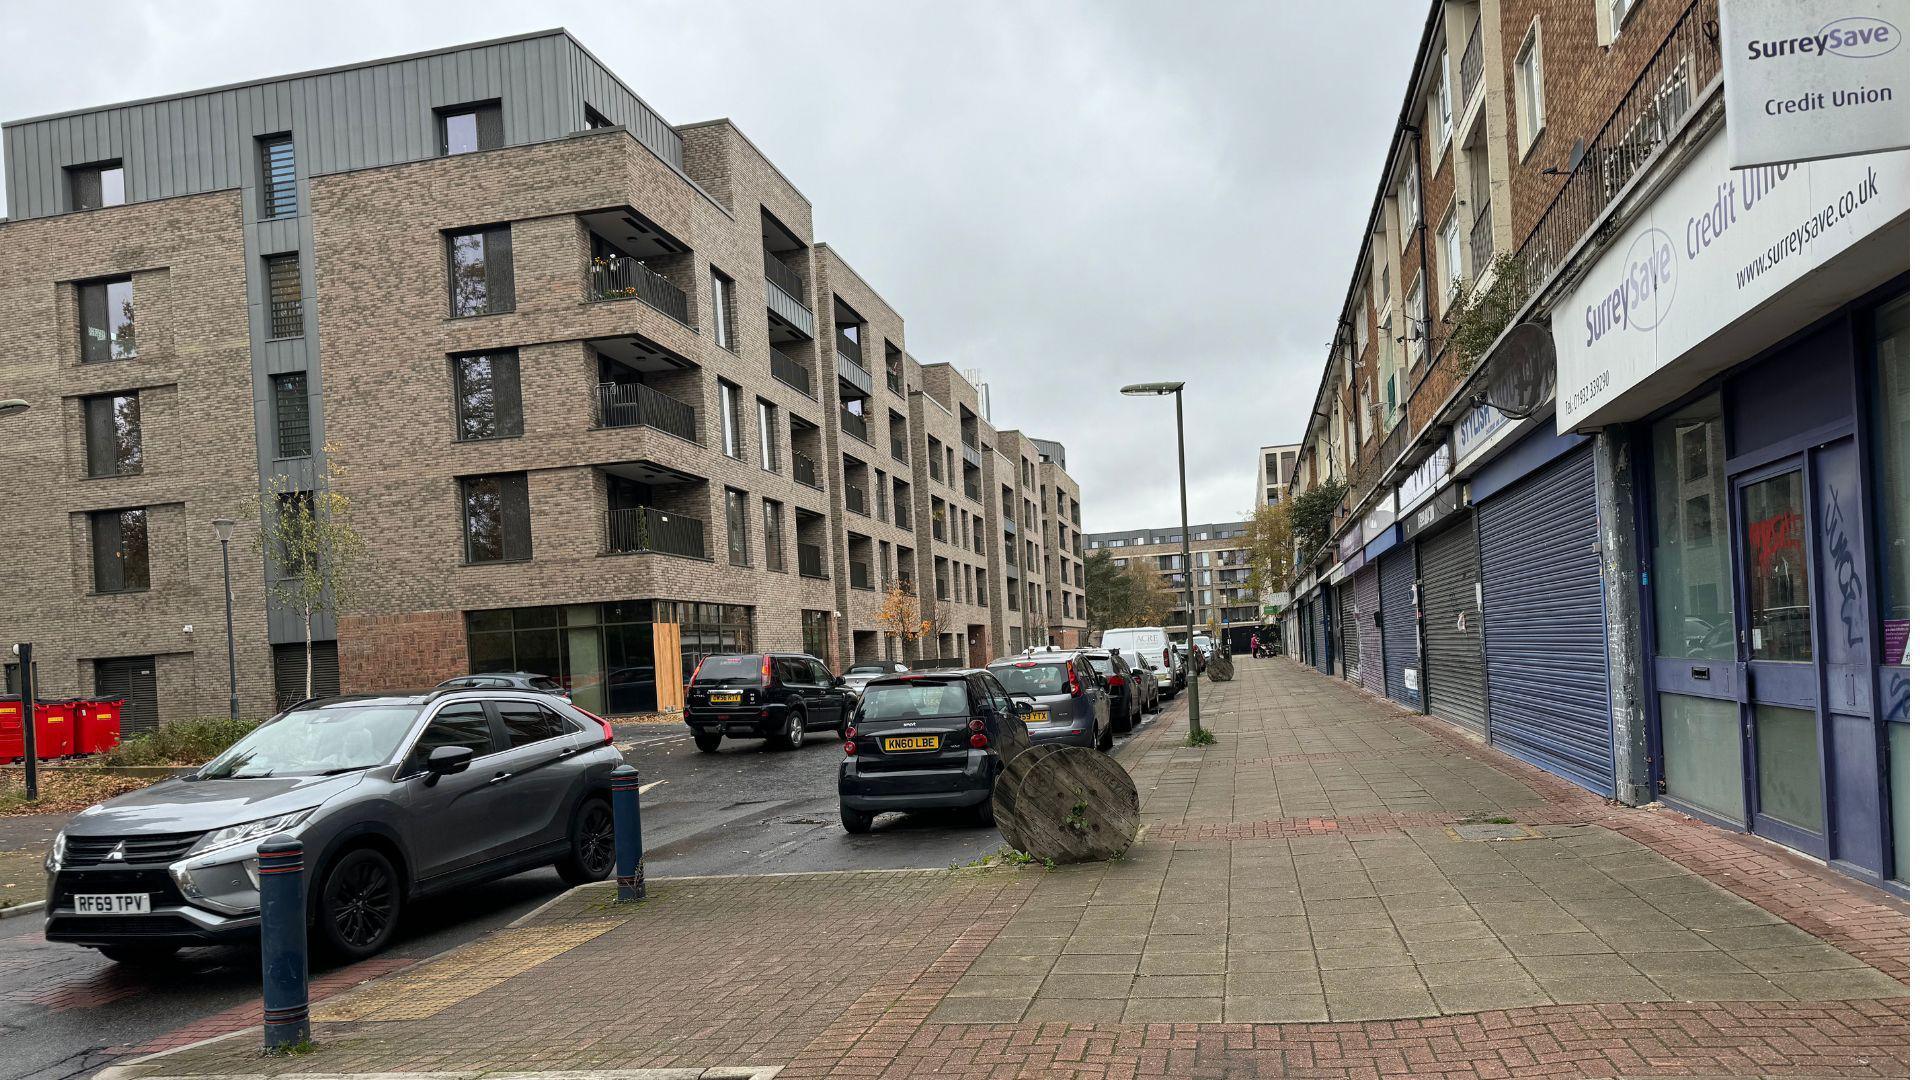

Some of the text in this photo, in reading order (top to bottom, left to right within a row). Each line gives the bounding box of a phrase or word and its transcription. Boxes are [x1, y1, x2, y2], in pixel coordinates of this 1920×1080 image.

[1747, 26, 1889, 60] SurreySave
[1765, 86, 1892, 116] Credit Union
[1736, 165, 1878, 290] www.surreysave.co.uk
[1586, 243, 1671, 347] SurreySave
[1686, 179, 1737, 260] Credit
[1032, 711, 1047, 720] YTX
[889, 737, 935, 749] KN60 LBE
[79, 895, 142, 912] RF69 TPV
